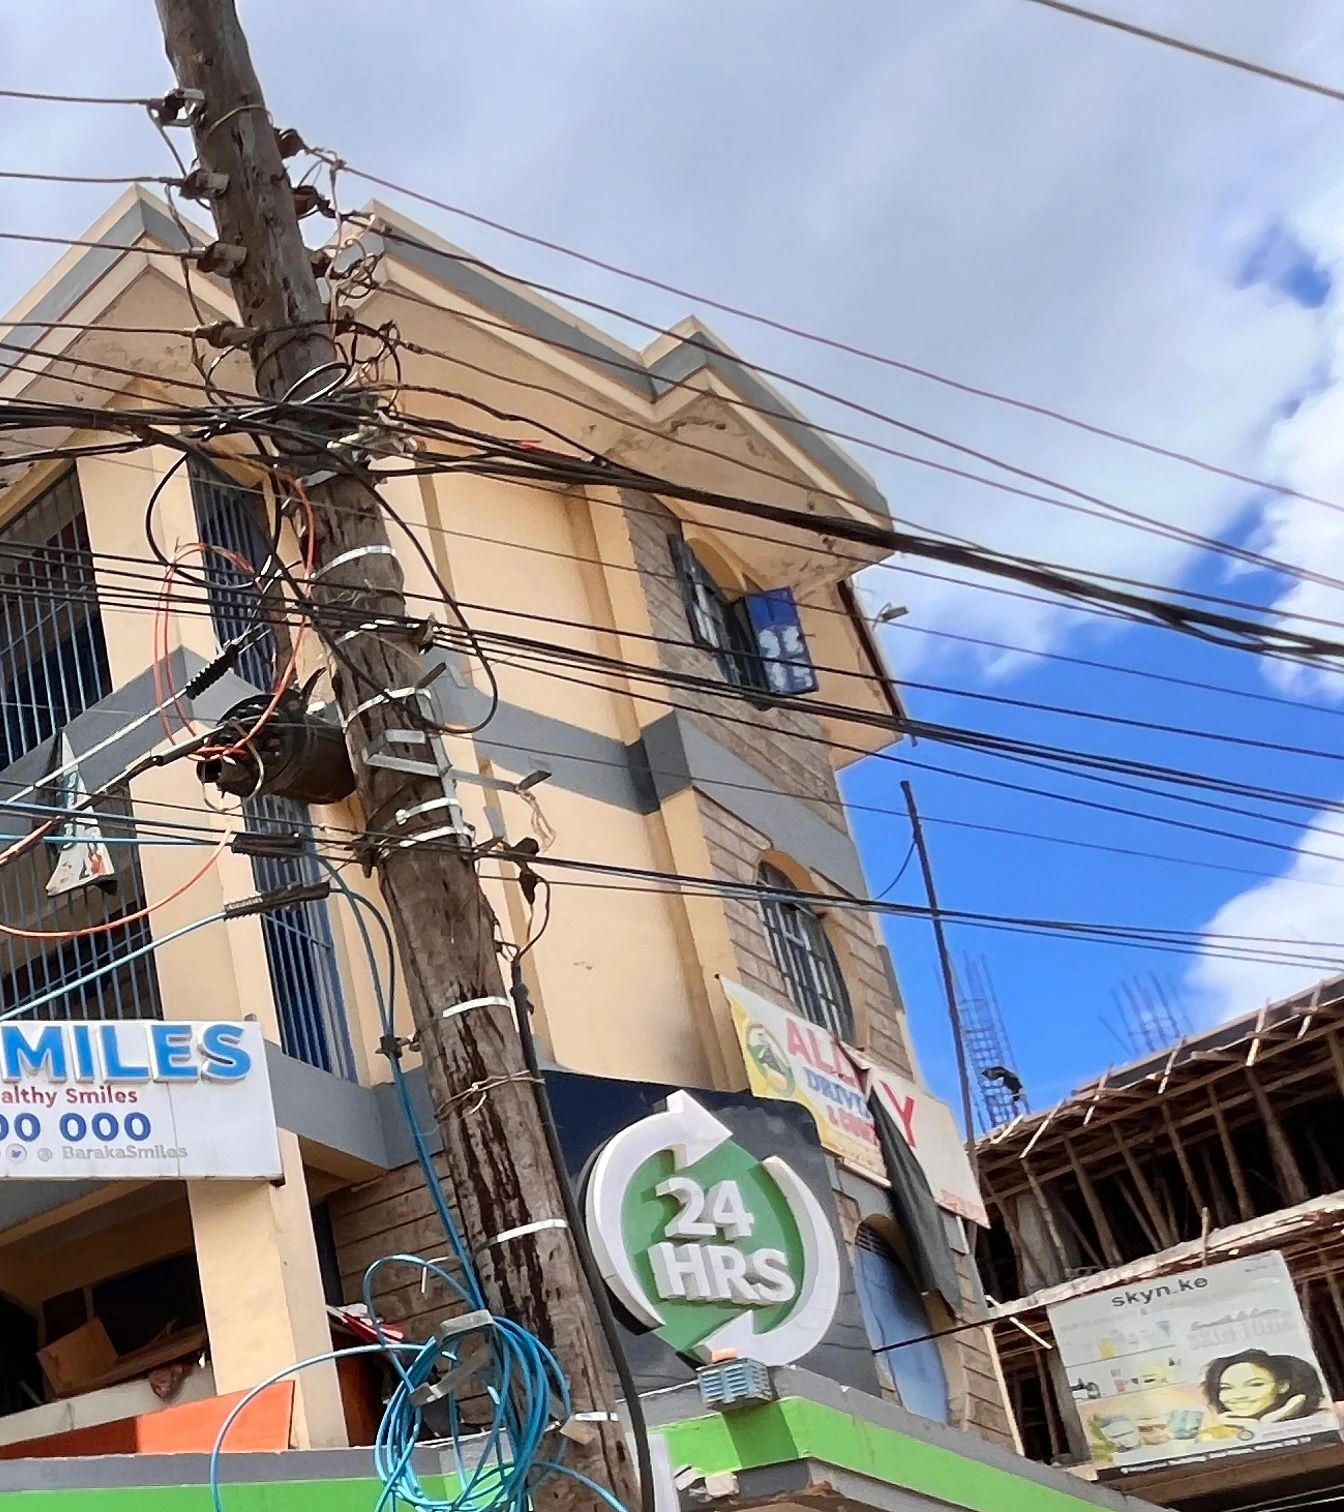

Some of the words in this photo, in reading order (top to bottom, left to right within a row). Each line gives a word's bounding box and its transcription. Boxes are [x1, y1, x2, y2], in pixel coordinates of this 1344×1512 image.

[66, 1085, 137, 1105] Smiles
[59, 1112, 151, 1142] 000
[62, 1144, 188, 1160] BarakaSmiles
[655, 1177, 754, 1240] 24
[648, 1242, 795, 1305] HRS
